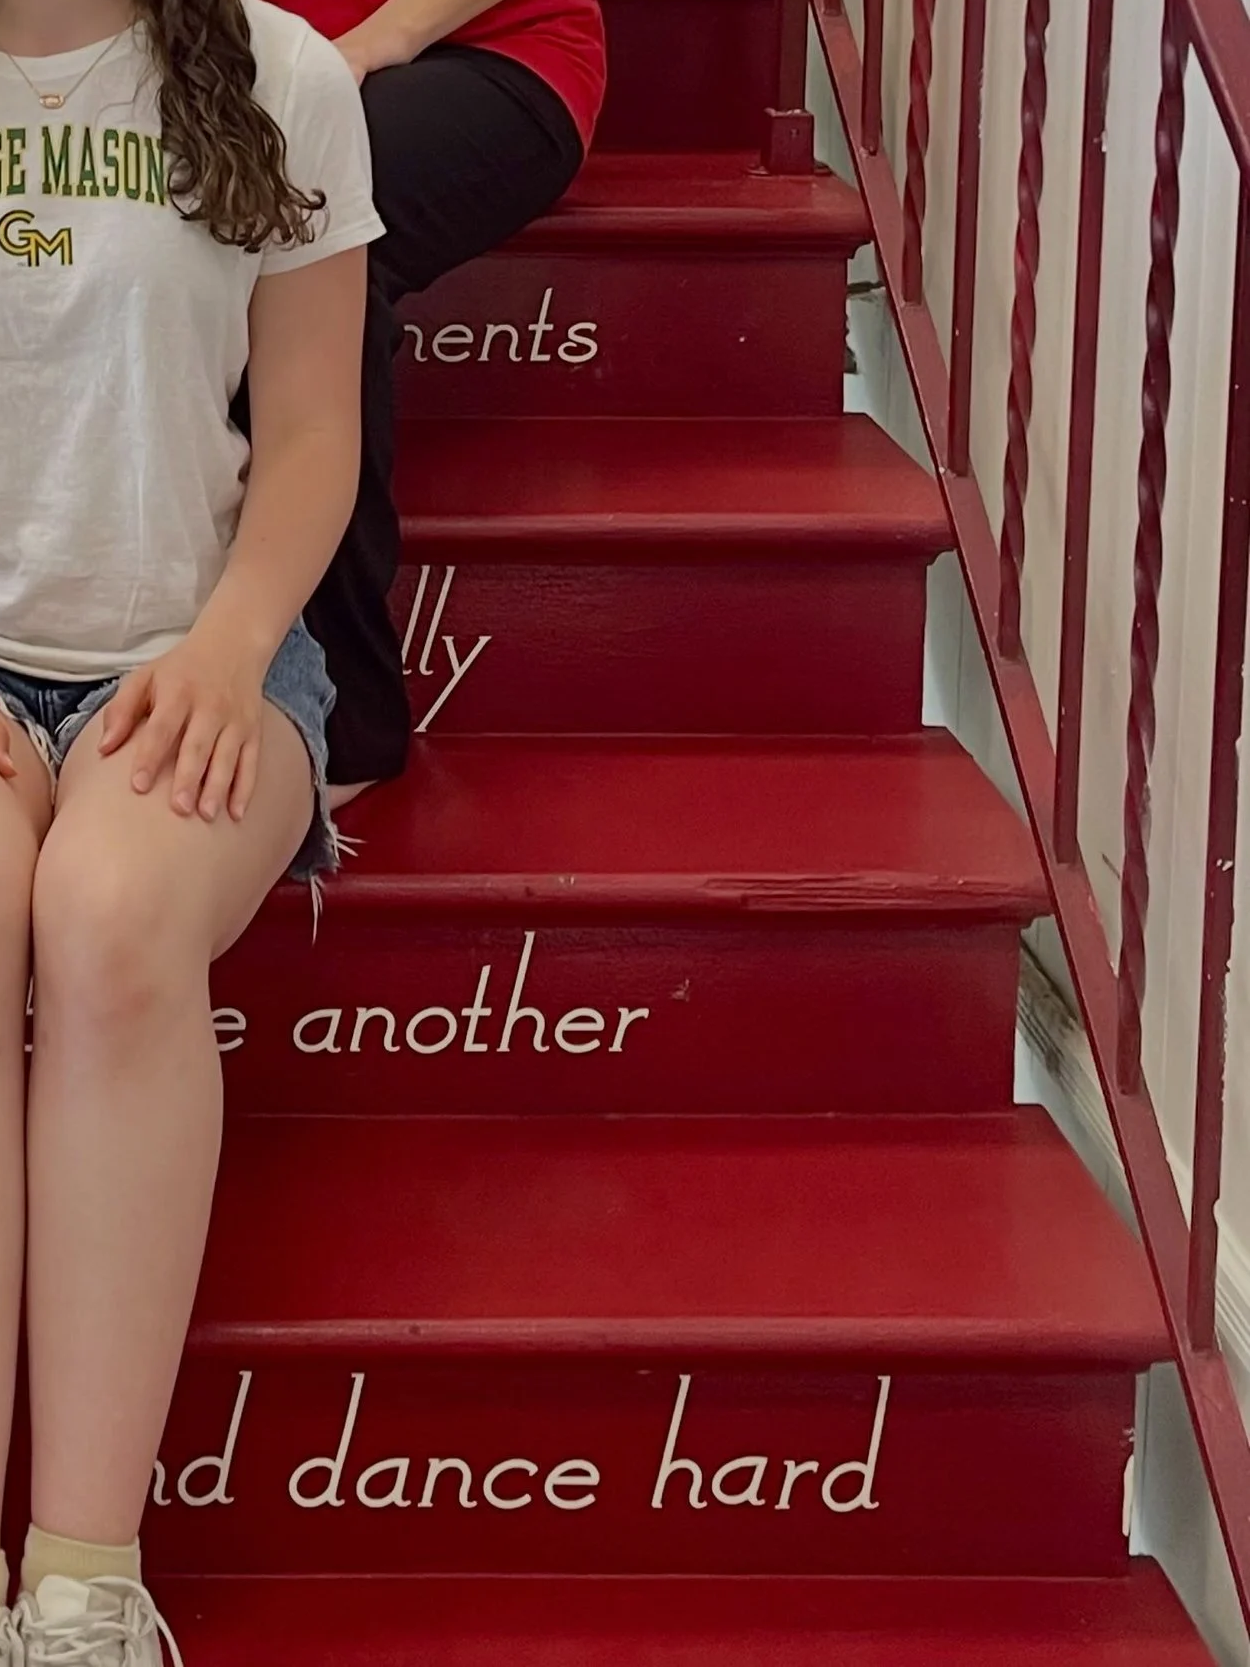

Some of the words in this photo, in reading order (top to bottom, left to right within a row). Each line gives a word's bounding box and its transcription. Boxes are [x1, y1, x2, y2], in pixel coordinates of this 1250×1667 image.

[40, 124, 166, 207] MASON
[400, 564, 493, 733] lly
[292, 930, 650, 1055] another
[287, 1371, 601, 1511] dance
[650, 1373, 892, 1514] hard
